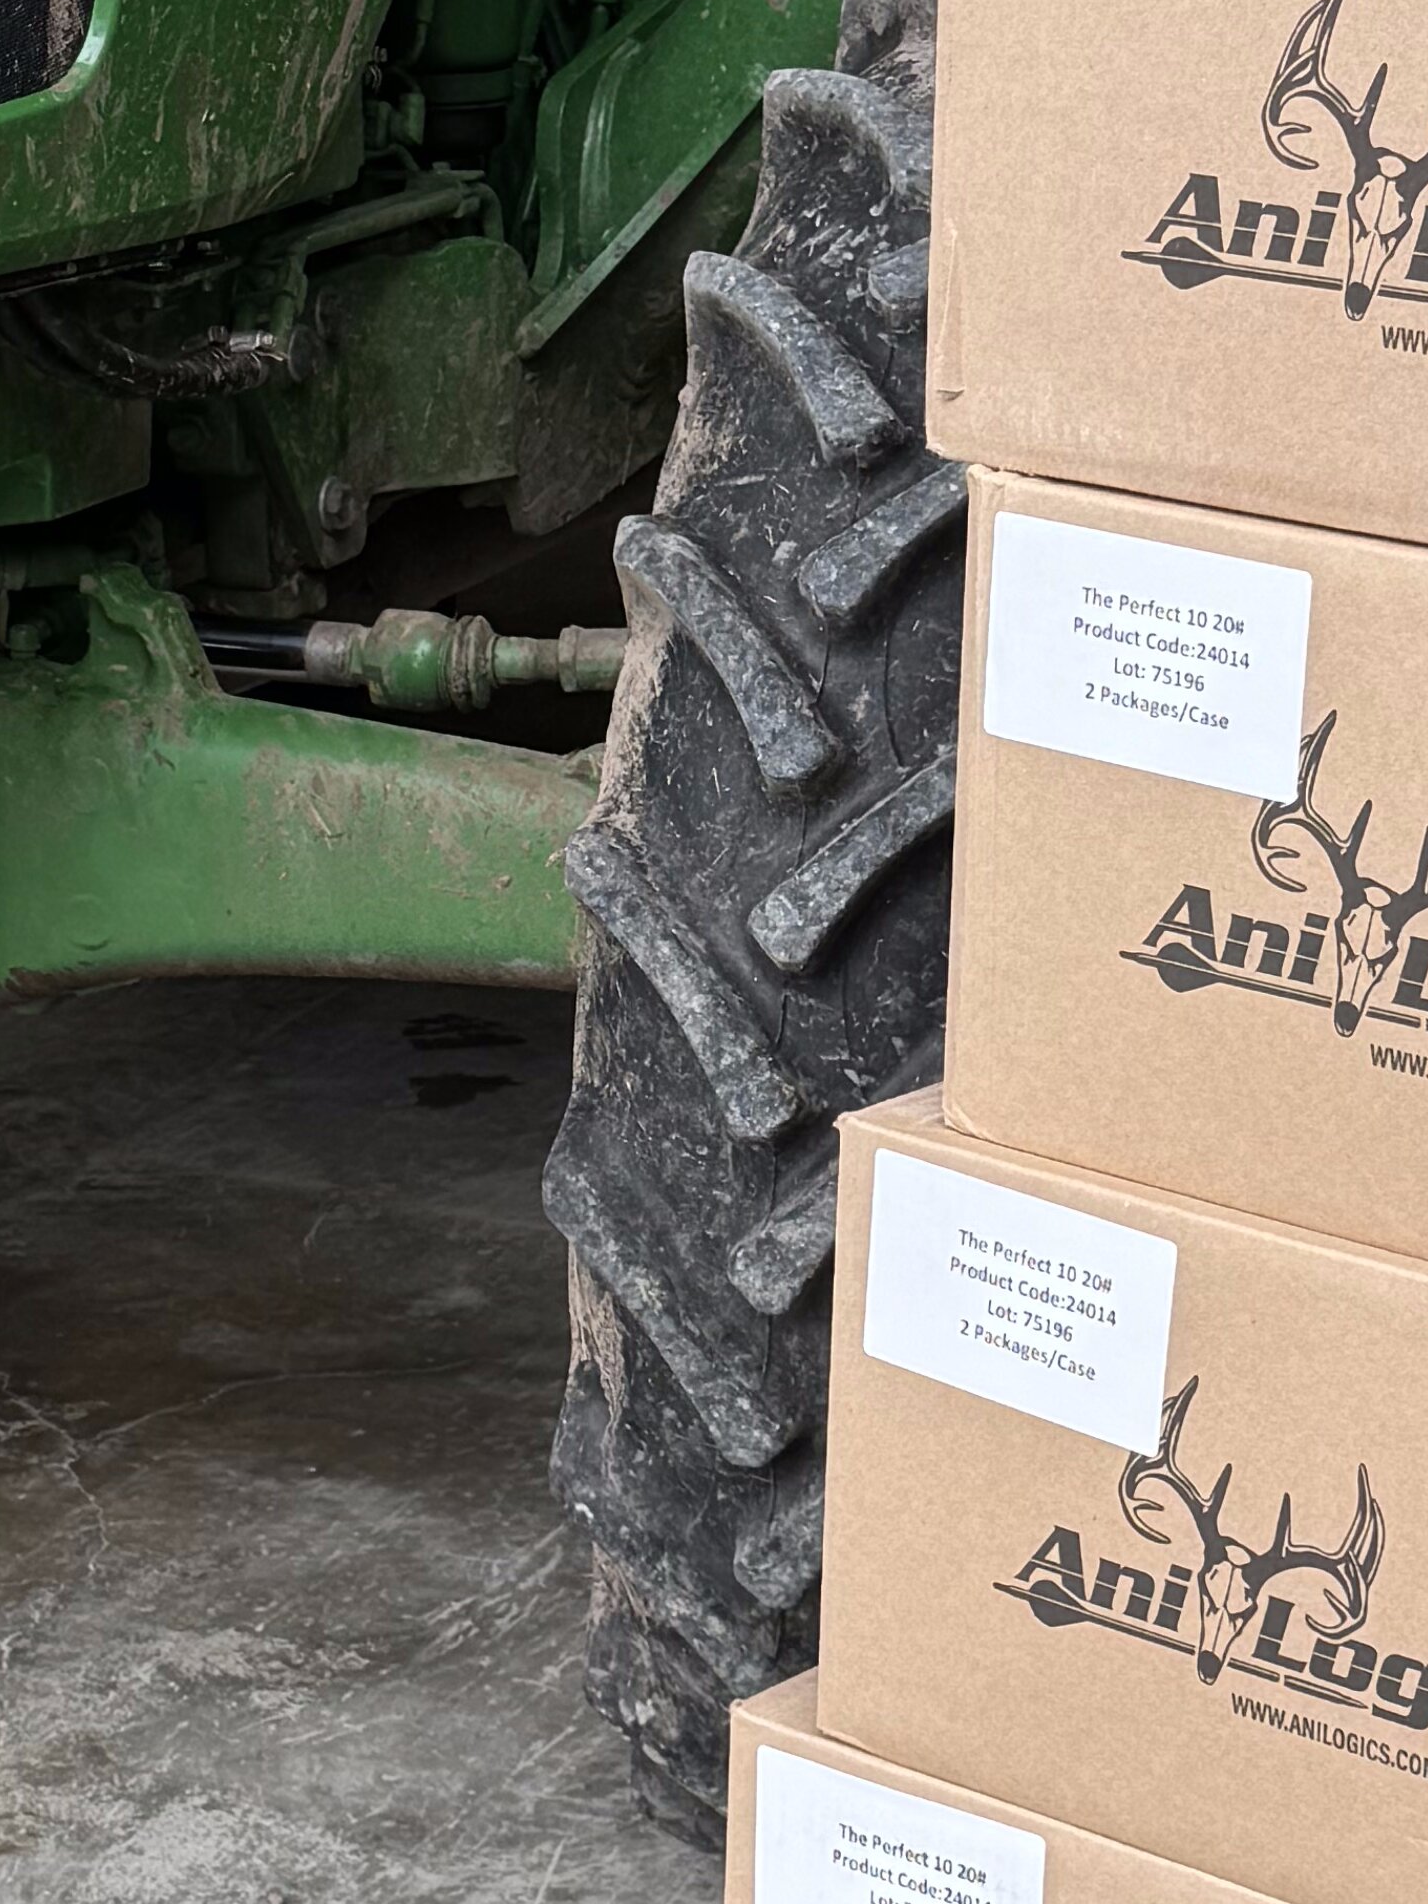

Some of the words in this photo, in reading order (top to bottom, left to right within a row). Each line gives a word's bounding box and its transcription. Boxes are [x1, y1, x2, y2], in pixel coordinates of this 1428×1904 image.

[1144, 171, 1343, 268] Ani
[1073, 616, 1142, 647] Product
[1145, 633, 1251, 670] Code:24014
[1081, 586, 1114, 609] The
[1118, 594, 1182, 624] Perfect
[1186, 608, 1209, 629] 10
[1212, 613, 1246, 636] 20#
[1113, 656, 1146, 680] Lot:
[1151, 665, 1206, 693] 75196
[1084, 683, 1096, 700] 2
[1100, 685, 1230, 731] Packages/Case
[1141, 883, 1330, 985] Ani
[949, 1255, 1015, 1293] Product
[1017, 1280, 1118, 1328] Code:24014
[958, 1228, 989, 1254] The
[992, 1240, 1053, 1276] Perfect
[1057, 1262, 1078, 1283] 10
[1081, 1270, 1113, 1295] 20#
[958, 1318, 970, 1336] 2
[973, 1325, 1097, 1382] Packages/Case
[986, 1299, 1019, 1325] Lot:
[1022, 1310, 1074, 1343] 75196
[1012, 1523, 1194, 1633] Ani
[832, 1848, 895, 1886] Product
[838, 1822, 868, 1848] The
[872, 1830, 930, 1869] Perfect
[934, 1855, 954, 1876] 10
[956, 1862, 988, 1887] 20#
